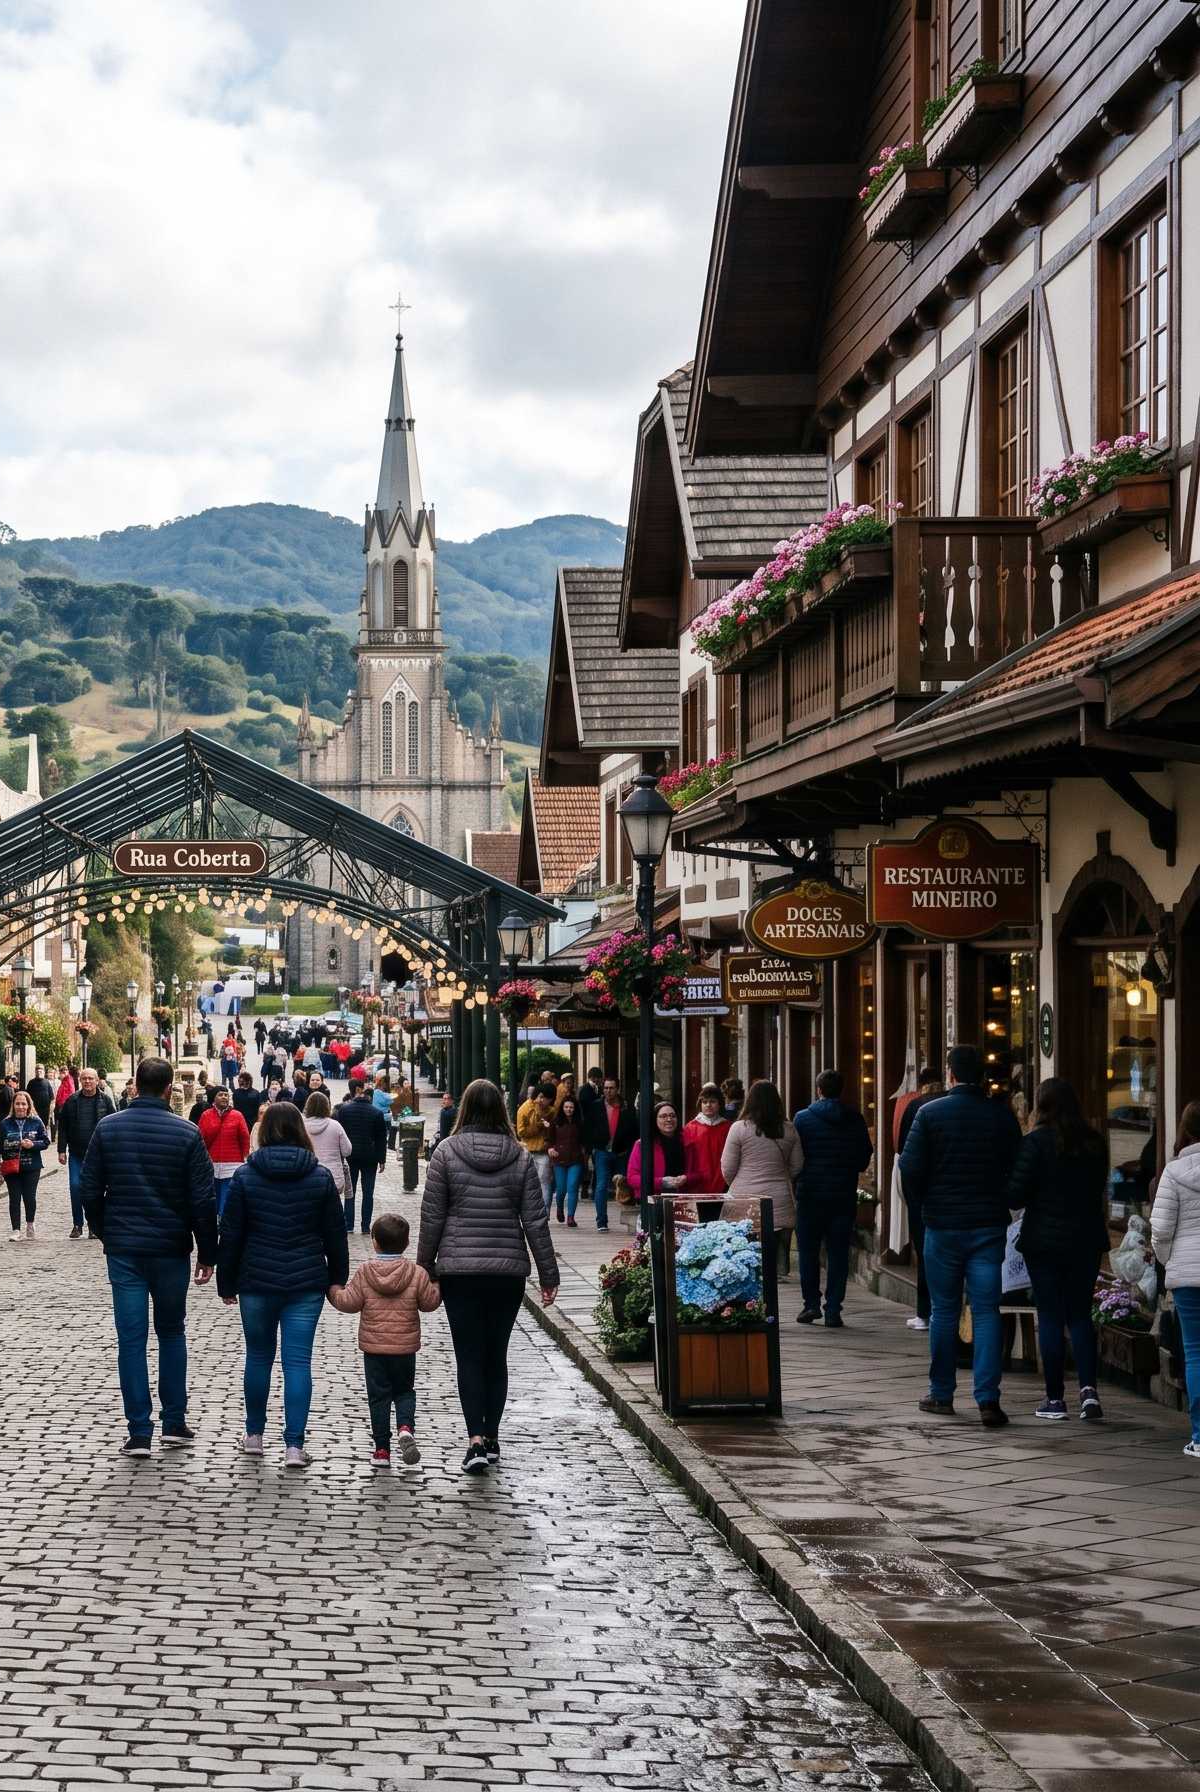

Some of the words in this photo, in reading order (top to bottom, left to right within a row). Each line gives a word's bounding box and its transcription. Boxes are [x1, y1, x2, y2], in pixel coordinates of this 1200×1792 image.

[130, 848, 167, 867] Rua
[174, 848, 251, 867] Coberta
[884, 867, 1026, 885] RESTAURANTE
[911, 891, 997, 908] MINEIRO
[786, 907, 843, 921] DOCES
[763, 924, 866, 938] ARTESANAIS
